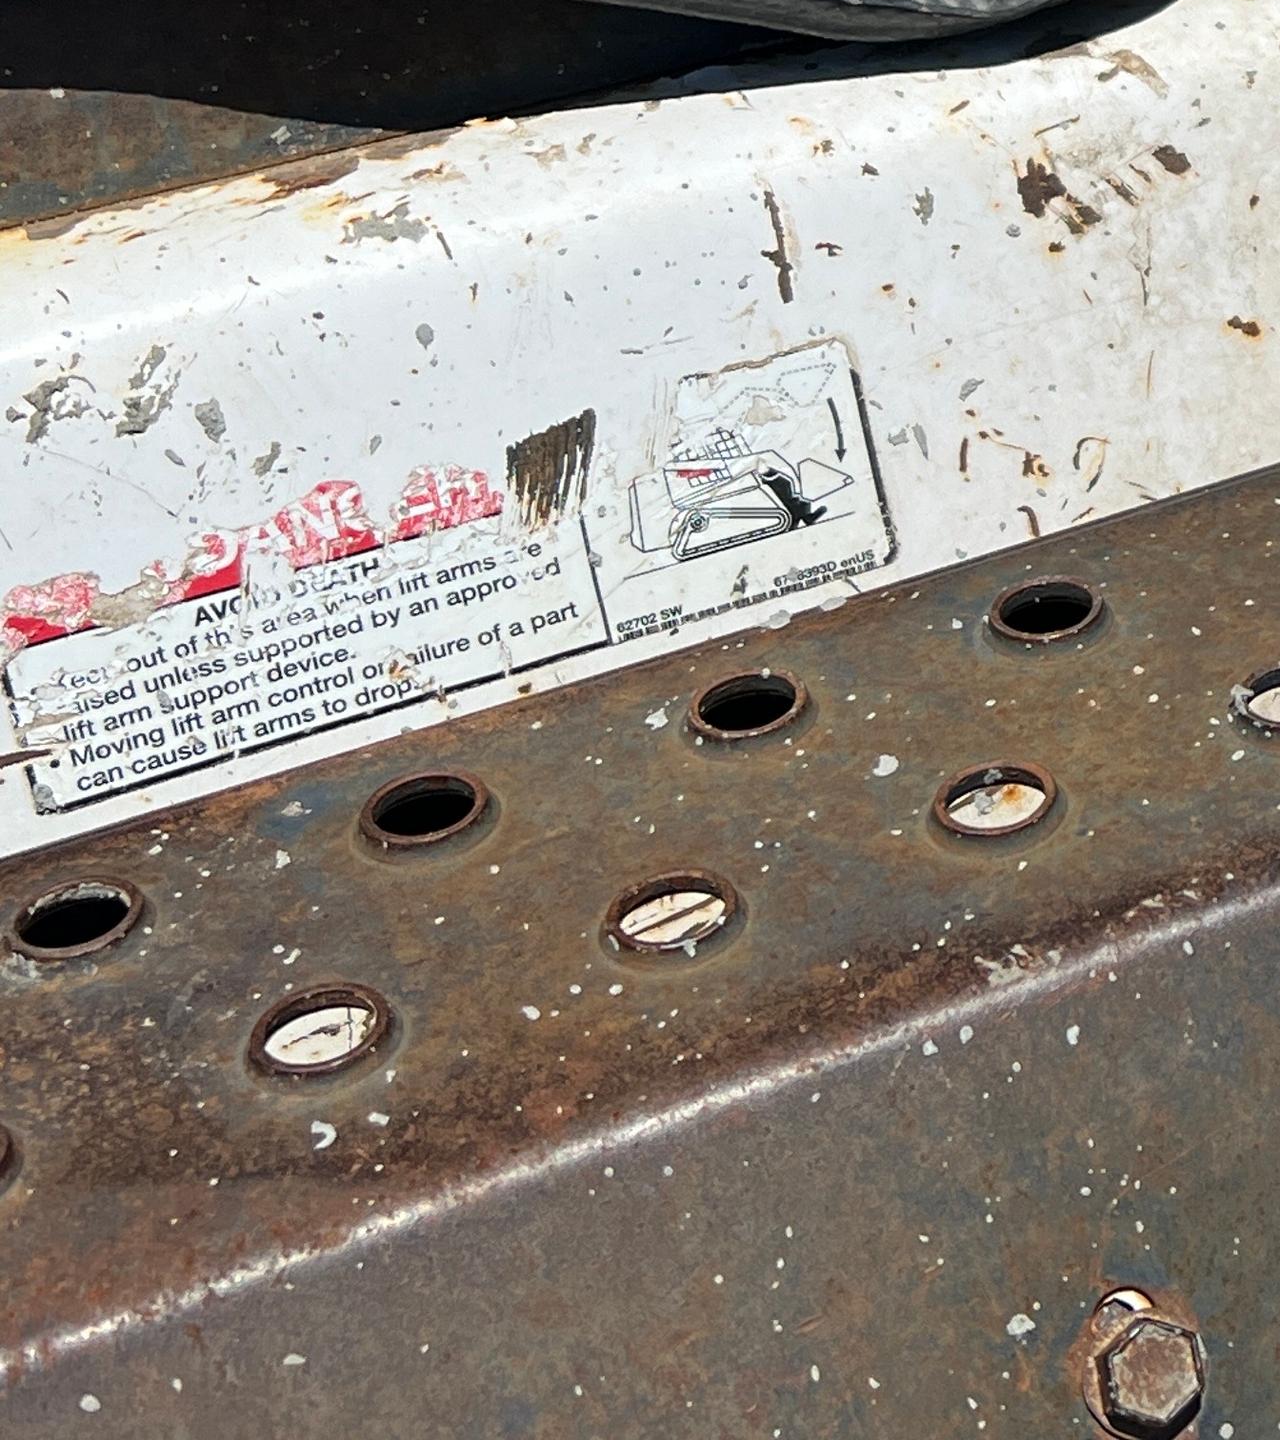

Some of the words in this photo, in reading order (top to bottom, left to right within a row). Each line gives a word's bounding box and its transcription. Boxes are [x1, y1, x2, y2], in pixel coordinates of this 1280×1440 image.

[126, 646, 168, 672] out
[174, 635, 198, 658] of
[204, 624, 254, 647] ths
[436, 556, 497, 585] arms
[504, 542, 541, 564] ae
[616, 611, 658, 633] 62702
[660, 604, 684, 623] SW
[773, 561, 837, 587] 678393D
[840, 549, 875, 567] enUS
[58, 679, 136, 714] aised
[143, 658, 227, 693] unless
[233, 613, 364, 667] supported
[371, 607, 400, 628] by
[408, 597, 439, 617] an
[62, 719, 96, 741] lift
[103, 705, 152, 732] arm
[160, 671, 260, 714] support
[267, 648, 356, 683] device.
[70, 727, 165, 768] Moving
[171, 712, 205, 736] lift
[211, 699, 260, 725] arm
[267, 664, 354, 708] control
[362, 662, 384, 679] or
[407, 637, 471, 665] ailure
[477, 623, 501, 646] of
[508, 621, 526, 638] a
[529, 601, 579, 634] part
[76, 766, 124, 791] can
[131, 740, 207, 776] cause
[253, 707, 316, 737] arms
[322, 697, 348, 717] to
[355, 679, 419, 707] drop.
